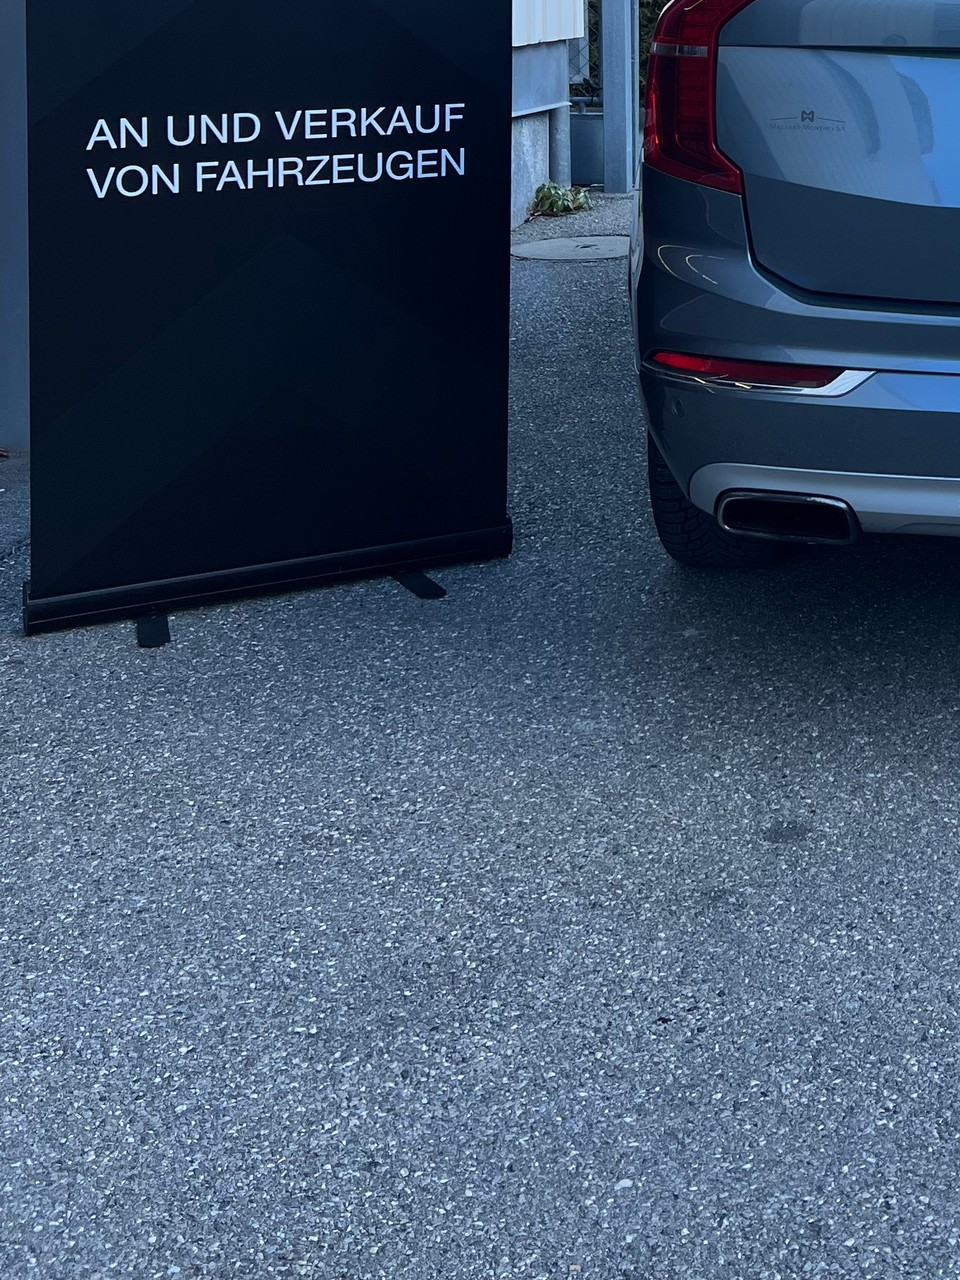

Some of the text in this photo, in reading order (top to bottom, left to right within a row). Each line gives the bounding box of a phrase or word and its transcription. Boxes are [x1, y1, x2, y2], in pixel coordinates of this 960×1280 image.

[86, 103, 465, 150] AN UND VERKAUF
[86, 147, 465, 199] VON FAHRZEUGEN
